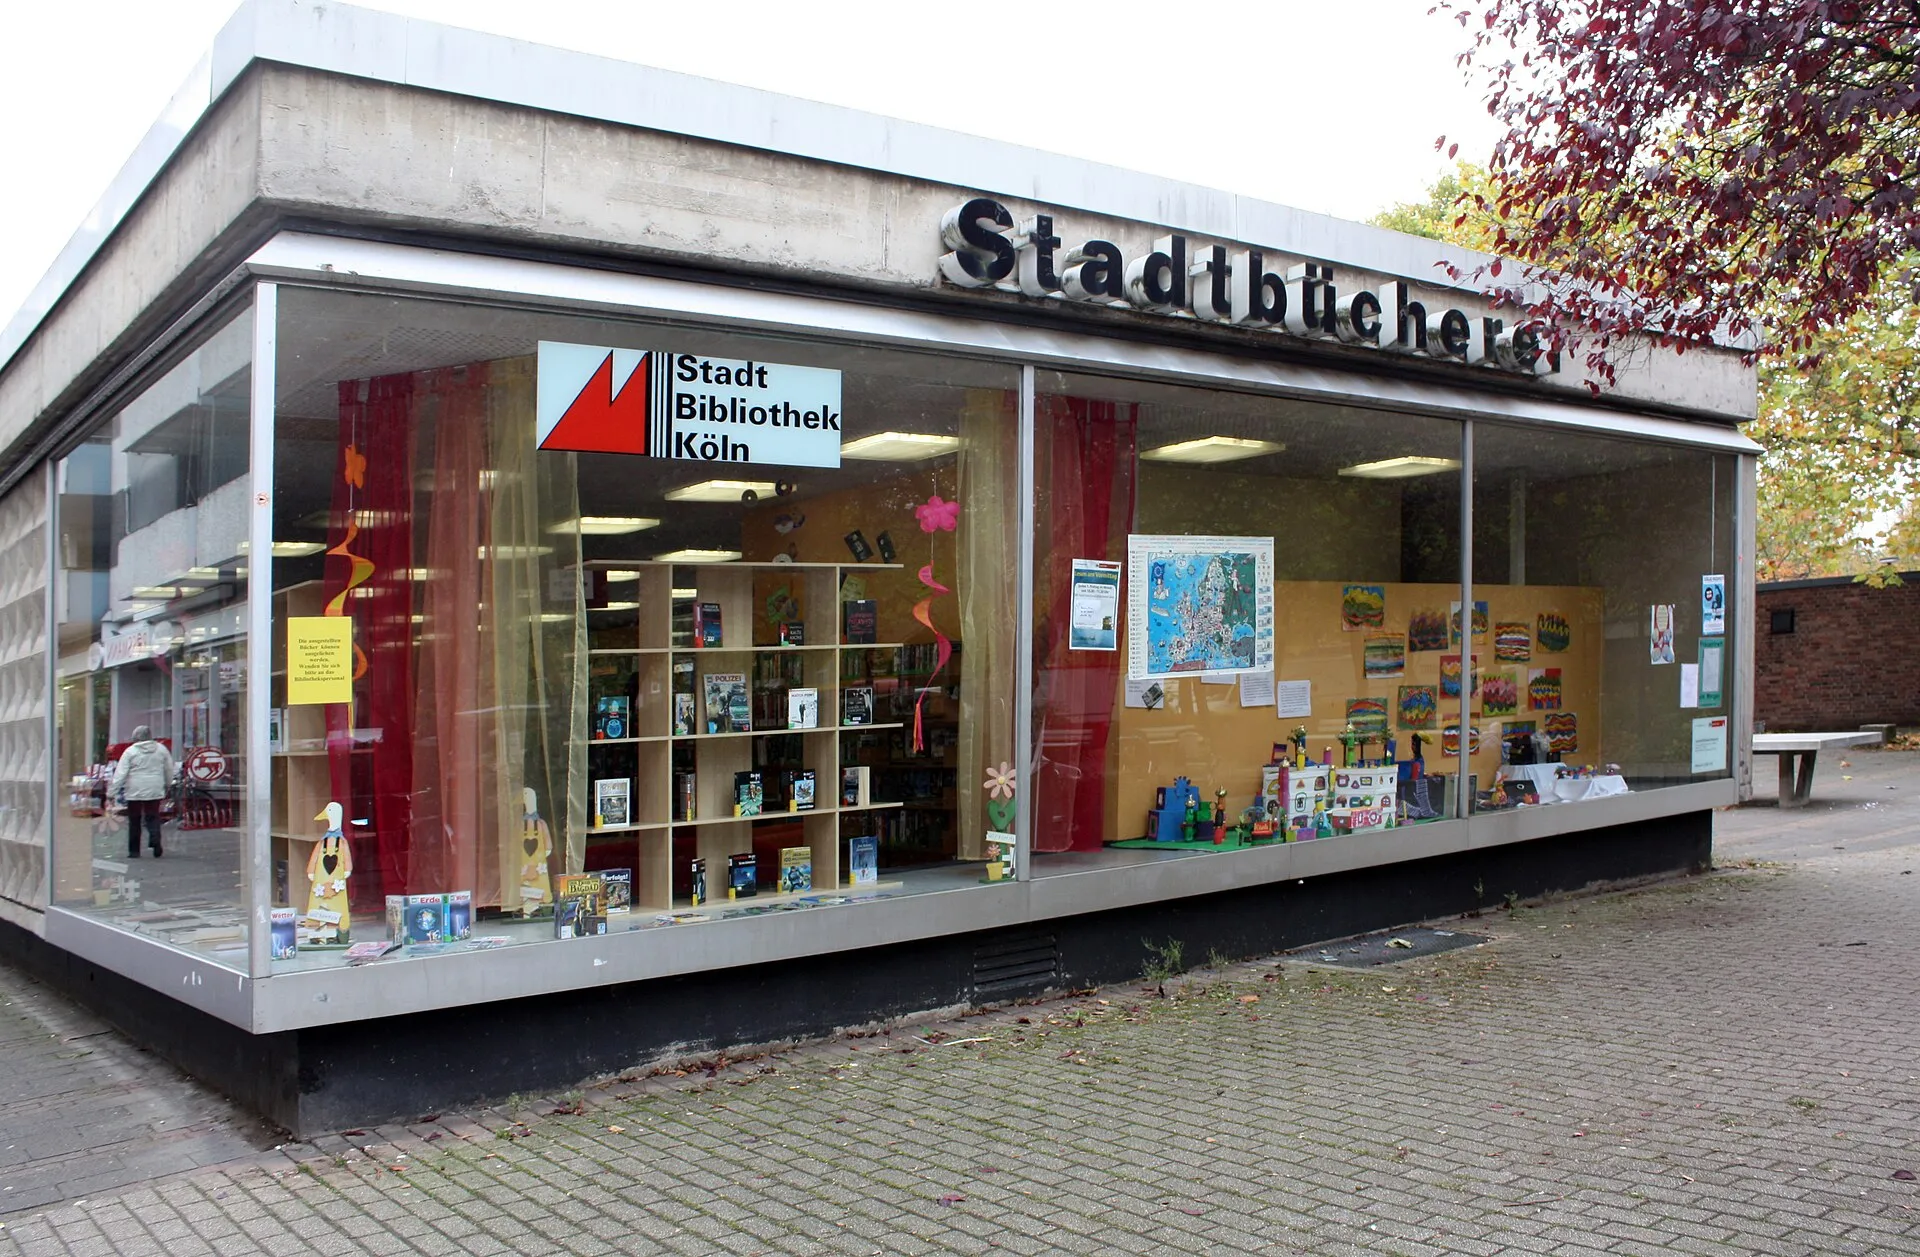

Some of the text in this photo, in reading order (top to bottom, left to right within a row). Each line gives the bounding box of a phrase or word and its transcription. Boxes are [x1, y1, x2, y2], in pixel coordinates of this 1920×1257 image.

[676, 354, 768, 389] Stadt
[675, 392, 840, 431] Bibliothek
[675, 431, 750, 462] Köln
[570, 884, 599, 893] BAGDAD
[420, 896, 440, 904] Erde
[271, 912, 293, 920] Wetter
